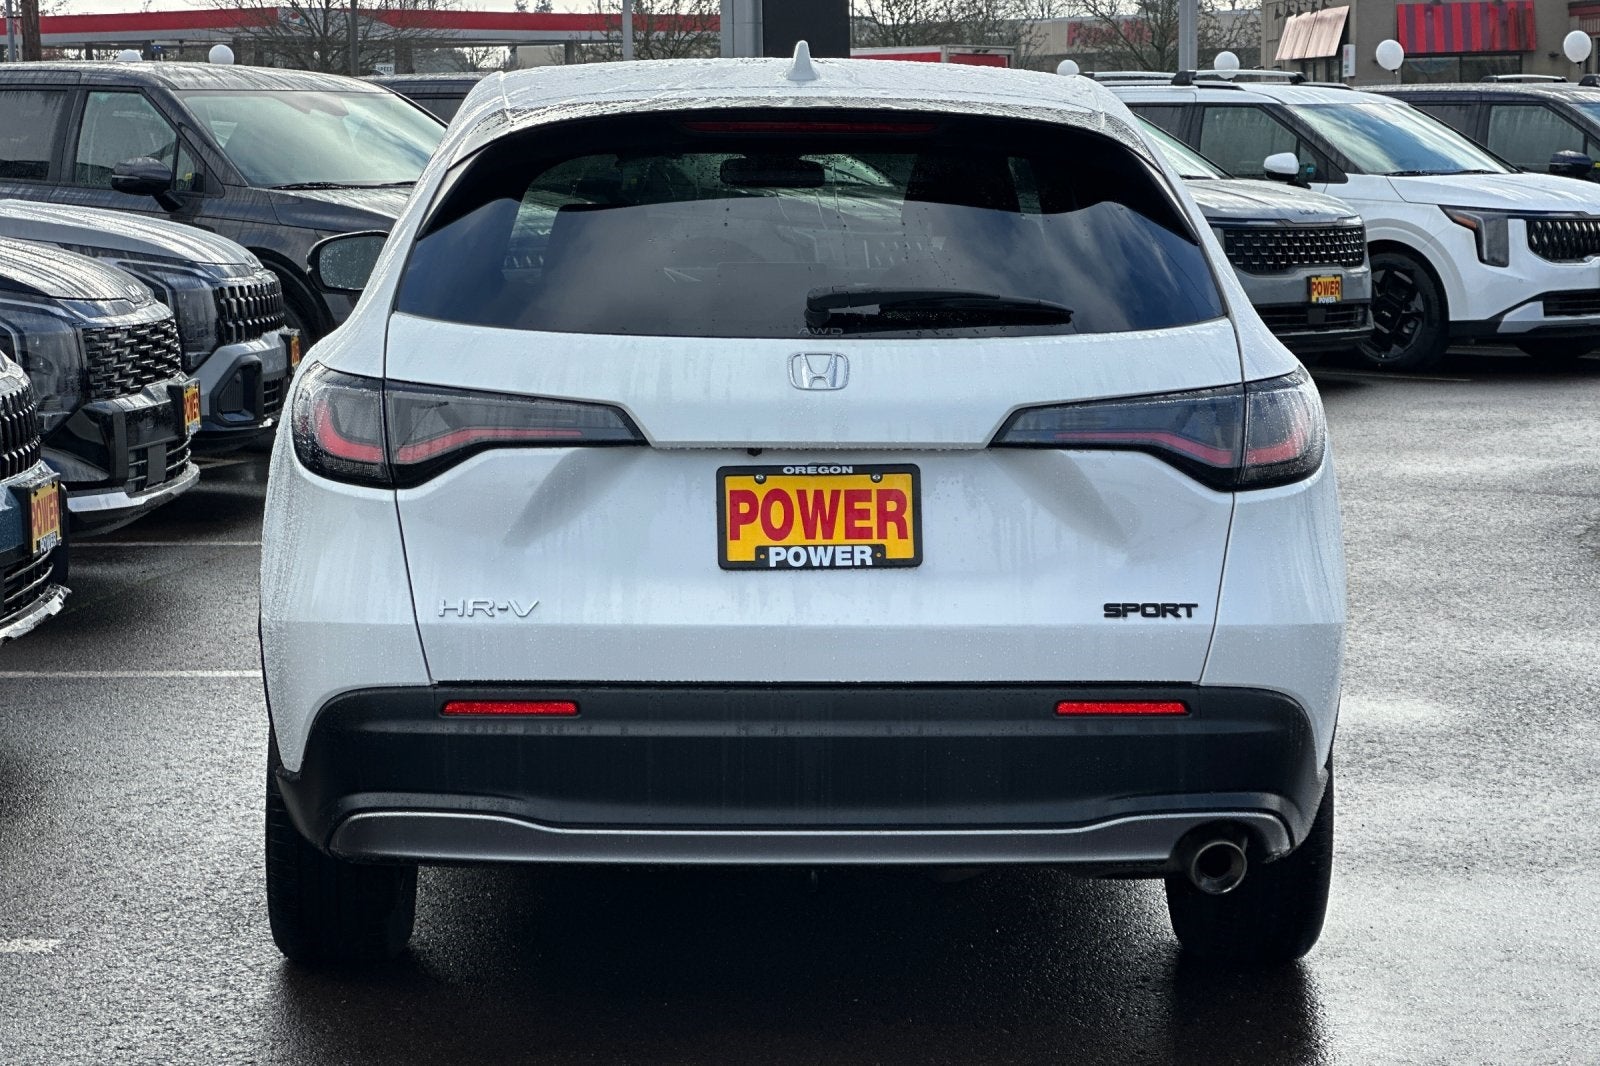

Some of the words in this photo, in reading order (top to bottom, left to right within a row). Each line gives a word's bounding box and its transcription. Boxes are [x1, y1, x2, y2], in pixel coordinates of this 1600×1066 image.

[1311, 280, 1340, 296] POWER
[797, 327, 843, 336] AWD
[783, 465, 854, 475] OREGON
[31, 491, 59, 538] POWER
[729, 487, 909, 542] POWER
[768, 545, 873, 567] POWER
[438, 599, 539, 618] HR-V
[1103, 602, 1199, 618] SPORT
